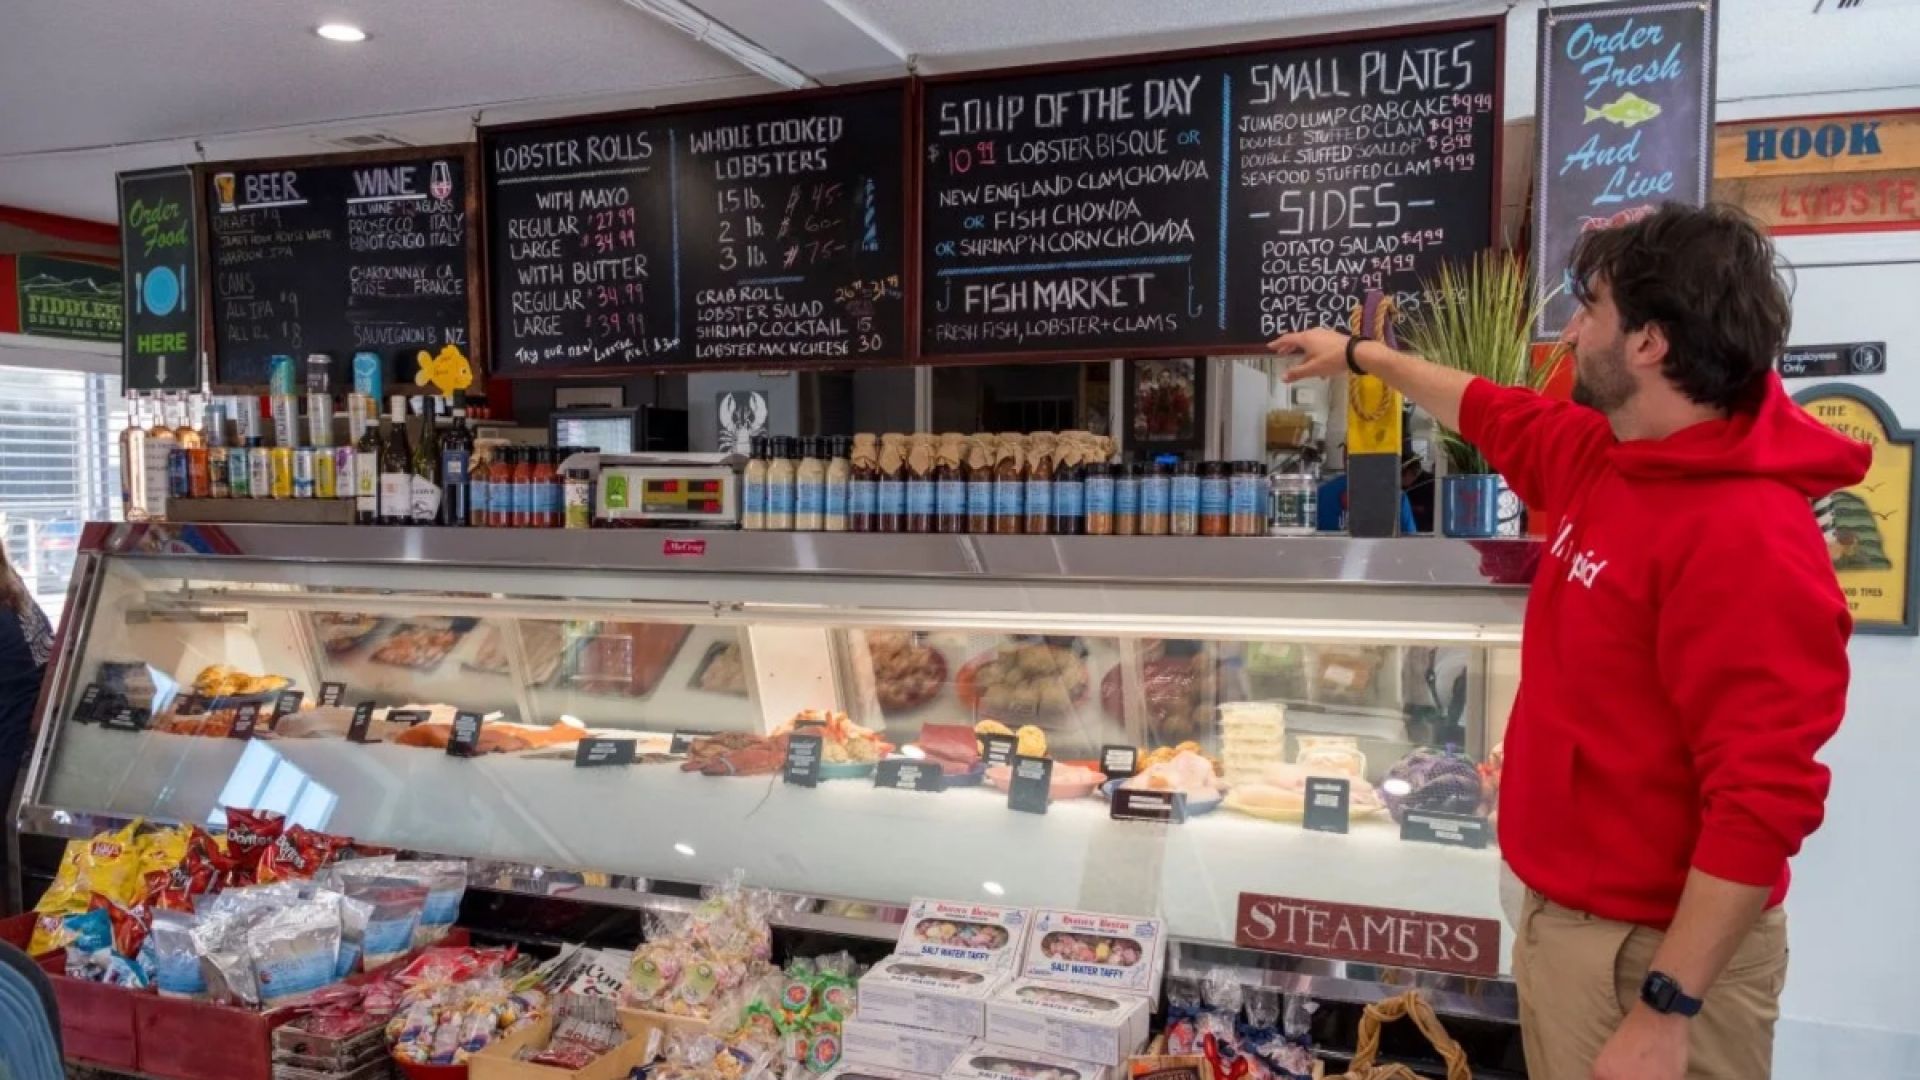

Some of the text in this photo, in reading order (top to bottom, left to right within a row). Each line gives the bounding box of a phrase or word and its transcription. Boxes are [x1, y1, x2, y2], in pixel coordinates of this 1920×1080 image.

[1566, 18, 1664, 61] Order
[1248, 40, 1475, 104] SMALL PLATES
[1580, 43, 1682, 100] Fresh
[939, 76, 1201, 136] SOUP OF THE DAY
[1238, 113, 1298, 133] JUMBO
[1300, 107, 1348, 128] LUMP
[690, 115, 843, 154] WHOLE COOKED
[1007, 135, 1093, 164] LOBSTER
[1097, 128, 1168, 157] BISQUE
[1177, 130, 1201, 145] OR
[1240, 119, 1425, 150] DOUBLE STUFFED CLAM
[1745, 121, 1882, 162] HOOK
[495, 132, 654, 172] LOBSTER ROLLS
[715, 148, 828, 180] LOBSTERS
[1241, 137, 1422, 168] DOUBLE STUFFED SCALLOP
[1560, 130, 1641, 176] And
[352, 166, 417, 195] WINE
[939, 159, 1209, 209] NEW ENGLAND CLAM CHOWDA
[1241, 159, 1431, 186] SEAFOOD STUFFED CLAM
[244, 171, 300, 202] BEER
[1592, 167, 1673, 206] Live
[129, 197, 180, 227] Order
[368, 200, 393, 214] WINE
[536, 187, 630, 212] WITH MAYO
[1278, 182, 1401, 234] SIDES
[348, 212, 464, 234] PROSECCO ITALY
[963, 198, 1142, 230] OR FISH CHOWDA
[142, 219, 188, 258] Food
[508, 216, 580, 239] REGULAR
[718, 220, 735, 244] 2
[936, 241, 956, 256] OR
[1049, 230, 1102, 253] CORN
[1103, 218, 1194, 248] CHOWDA
[350, 233, 385, 252] PINOT
[430, 230, 464, 247] ITALY
[510, 239, 562, 260] LARGE
[1262, 235, 1400, 258] POTATO SALAD
[518, 254, 649, 285] WITH BUTTER
[719, 247, 737, 271] 3
[1262, 257, 1367, 275] COLESLAW
[219, 272, 256, 295] CANS
[350, 264, 454, 280] CHARDONNAY CA
[351, 278, 464, 295] ROSE FRANCE
[696, 286, 784, 305] CRAB ROLL
[965, 272, 1156, 314] FISH MARKET
[227, 300, 247, 320] ALL
[248, 299, 275, 319] IPA
[512, 288, 585, 314] REGULAR
[698, 300, 824, 322] LOBSTER SALAD
[1260, 294, 1361, 313] CAPE COD
[353, 325, 425, 345] SAUVIGNON
[445, 326, 467, 344] NZ
[513, 315, 563, 338] LARGE
[696, 316, 873, 339] SHRIMP COCKTAIL 15
[936, 322, 977, 342] FRESH
[982, 320, 1024, 344] FISH,
[137, 332, 187, 352] HERE
[696, 343, 757, 358] LOBSTER
[759, 342, 788, 356] MAC
[857, 334, 883, 352] 30
[1783, 352, 1837, 363] Employees
[1783, 363, 1806, 374] Only
[1817, 405, 1847, 416] THE
[1243, 900, 1480, 964] STEAMERS
[921, 945, 990, 961] SALT WATER TAFFY
[1051, 962, 1124, 979] SALT WATER TAFFY
